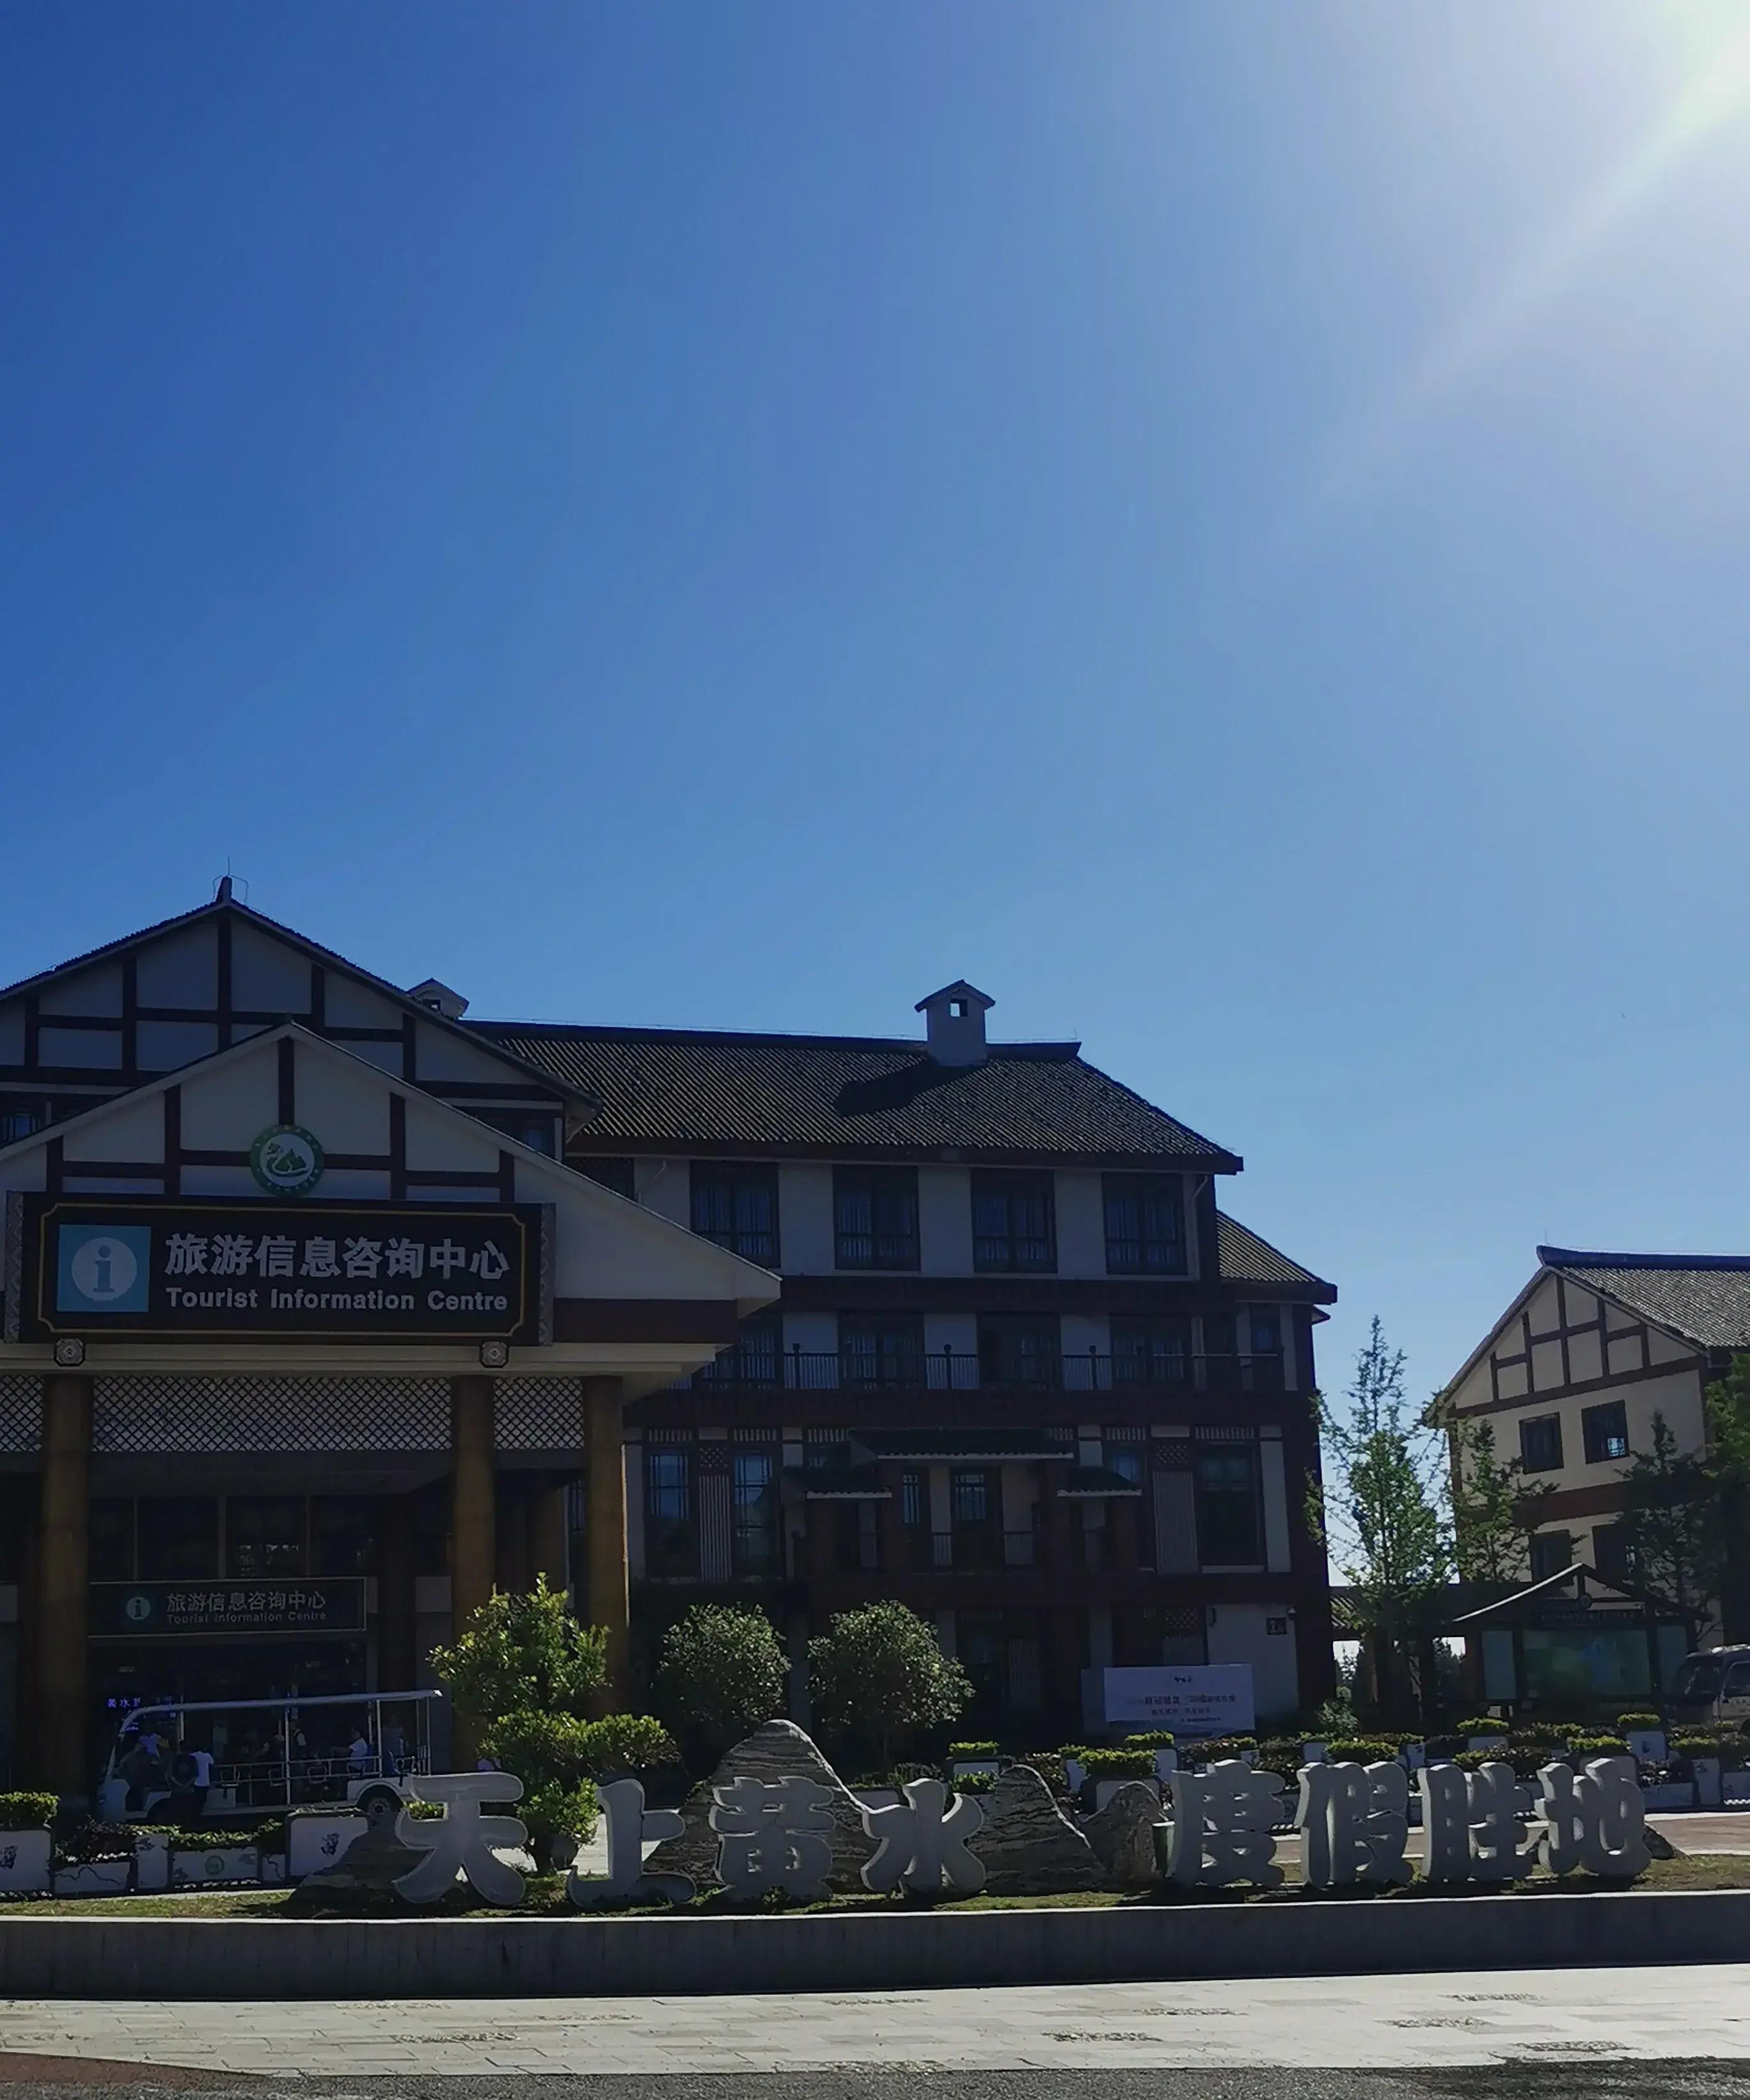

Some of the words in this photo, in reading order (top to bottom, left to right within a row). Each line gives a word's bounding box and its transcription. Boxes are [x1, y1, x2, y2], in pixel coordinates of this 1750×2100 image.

[164, 1232, 510, 1280] 旅游信息咨询中心
[166, 1287, 258, 1309] Tourist
[271, 1288, 415, 1310] Information
[427, 1290, 509, 1311] Centre
[166, 1590, 327, 1613] 旅游信息咨询中心
[167, 1614, 210, 1625] Tourist
[214, 1612, 283, 1623] Information
[288, 1611, 327, 1621] Centre
[392, 1771, 985, 1909] 天上黄水
[1165, 1758, 1651, 1890] 度假胜地
